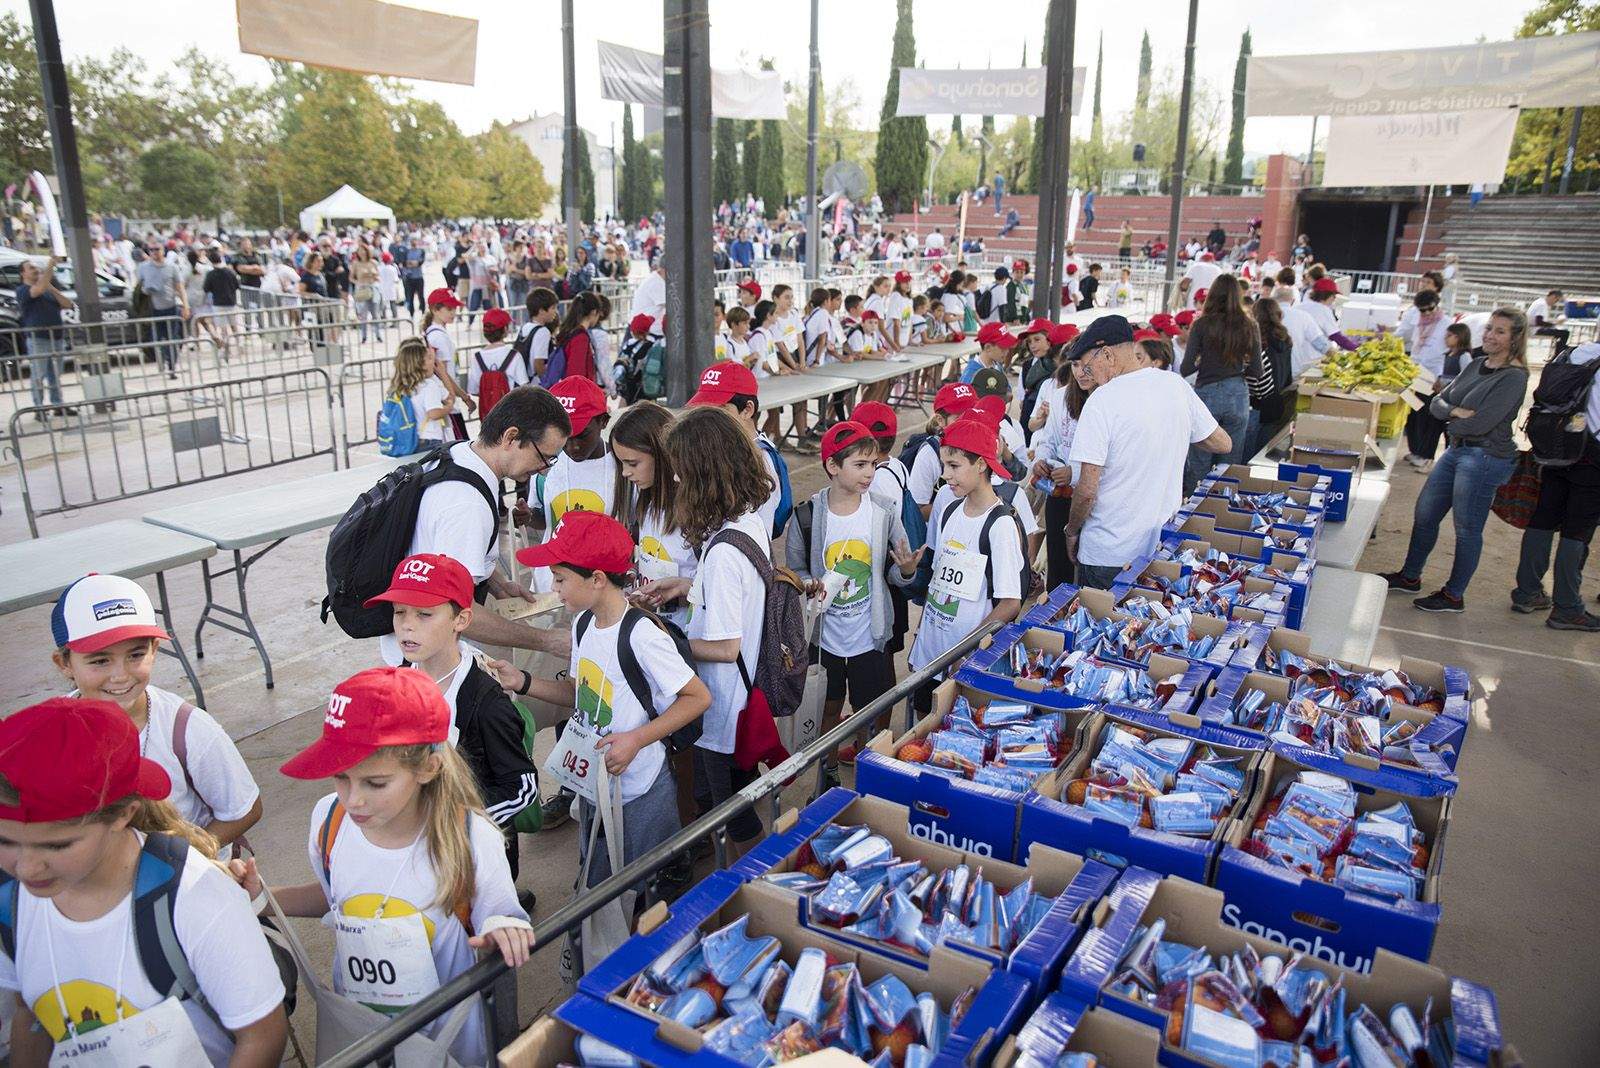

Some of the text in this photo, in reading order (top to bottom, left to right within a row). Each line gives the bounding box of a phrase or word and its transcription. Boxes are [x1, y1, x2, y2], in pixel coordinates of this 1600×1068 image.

[939, 566, 964, 586] 130
[329, 693, 352, 717] OT
[562, 750, 590, 778] 043
[347, 955, 397, 985] 090
